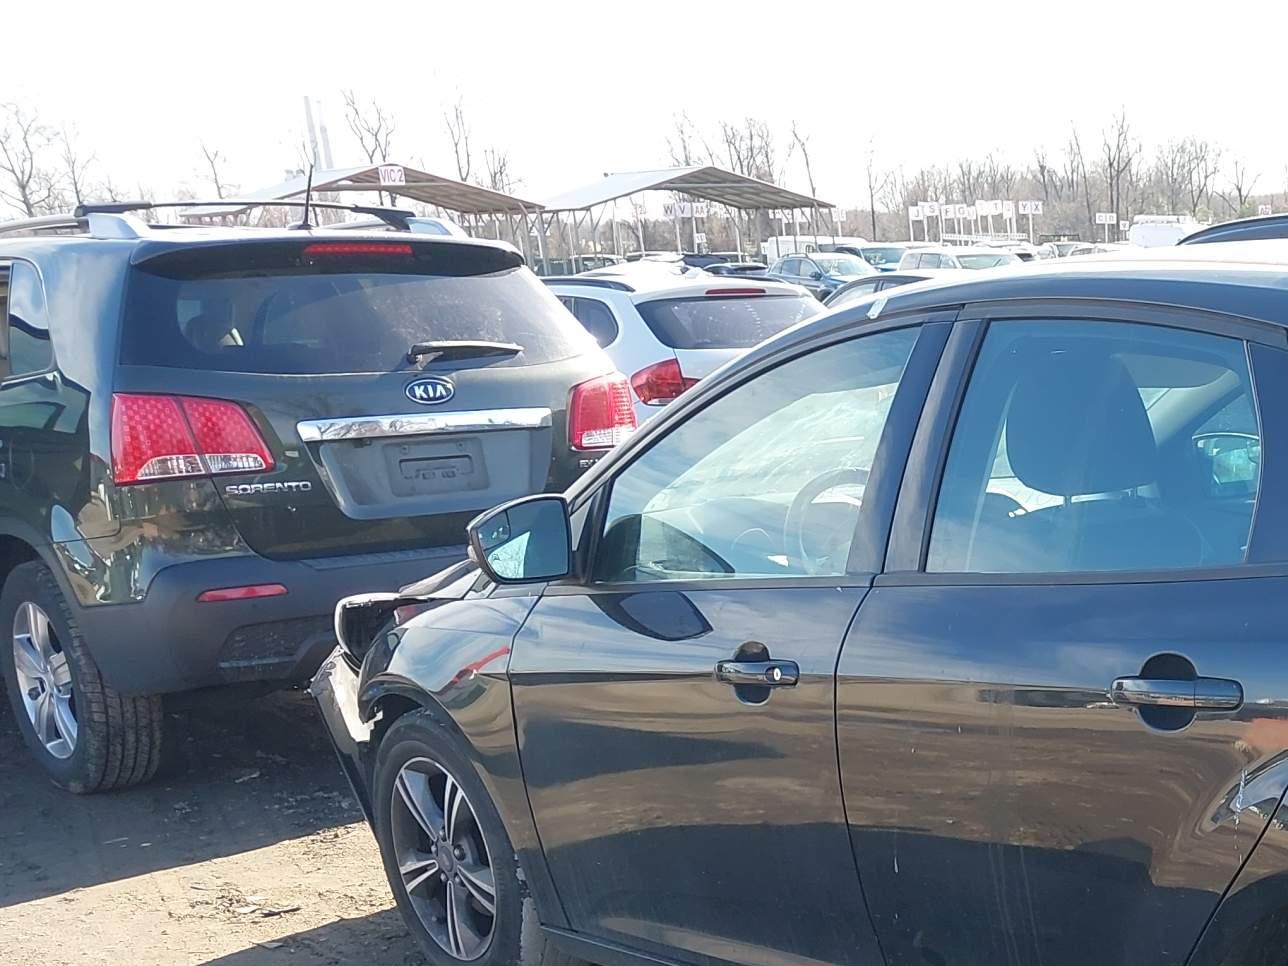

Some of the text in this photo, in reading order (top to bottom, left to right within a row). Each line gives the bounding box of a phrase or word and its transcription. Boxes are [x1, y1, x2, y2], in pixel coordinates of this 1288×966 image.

[380, 168, 404, 183] VIC 2
[679, 204, 686, 214] V
[1021, 202, 1028, 213] Y
[1033, 202, 1041, 213] X
[413, 384, 447, 399] KIA
[225, 481, 313, 495] SORENTO
